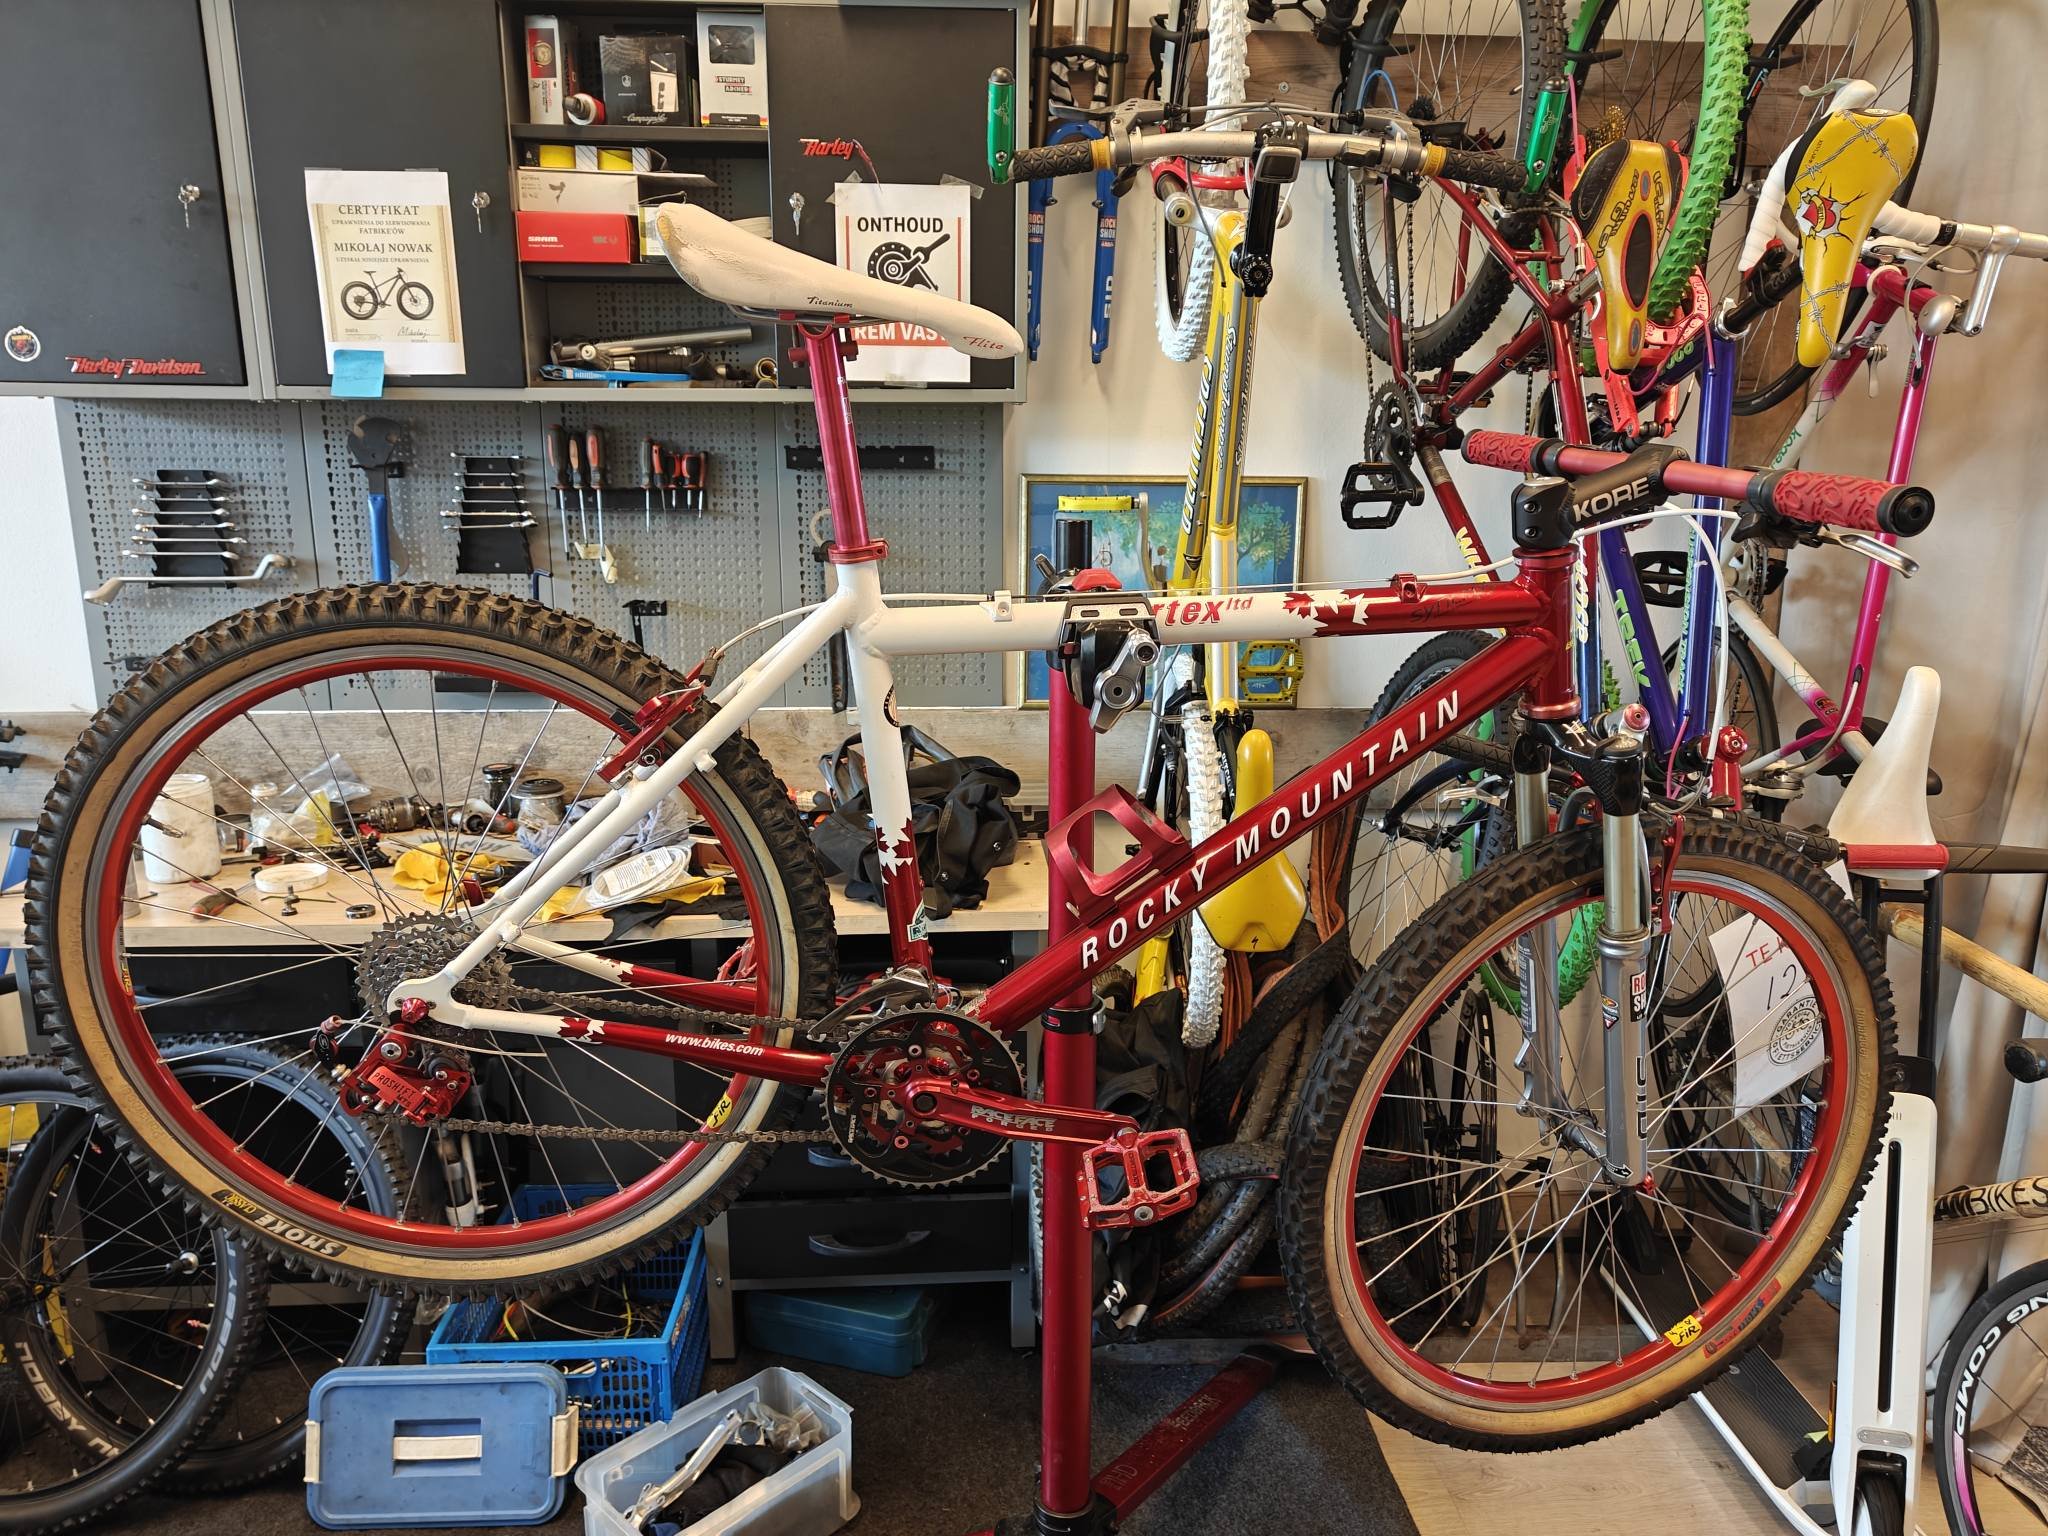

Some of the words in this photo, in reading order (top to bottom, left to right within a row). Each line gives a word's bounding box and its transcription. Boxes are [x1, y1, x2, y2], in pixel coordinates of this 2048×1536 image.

[799, 137, 854, 160] Harley
[338, 204, 420, 216] CERTYFIKAT
[857, 216, 944, 233] ONTHOUD
[388, 243, 433, 253] NOWAK
[807, 296, 853, 309] Titanium
[854, 322, 896, 341] REM
[899, 321, 947, 342] VAS
[963, 335, 1004, 351] Flite
[65, 356, 206, 379] Harley-Davidson
[1181, 354, 1213, 535] SPECIALIZED
[1572, 477, 1650, 522] KORE
[1614, 589, 1651, 687] TREK
[1080, 855, 1213, 970] ROCKY
[1235, 690, 1460, 866] MOUNTAIN
[665, 1034, 765, 1056] www.bikes.com
[373, 1071, 417, 1100] PROSHIFT
[254, 1214, 339, 1255] SMOKE
[15, 1341, 87, 1432] NOBBY
[1953, 1325, 2001, 1436] COMP
